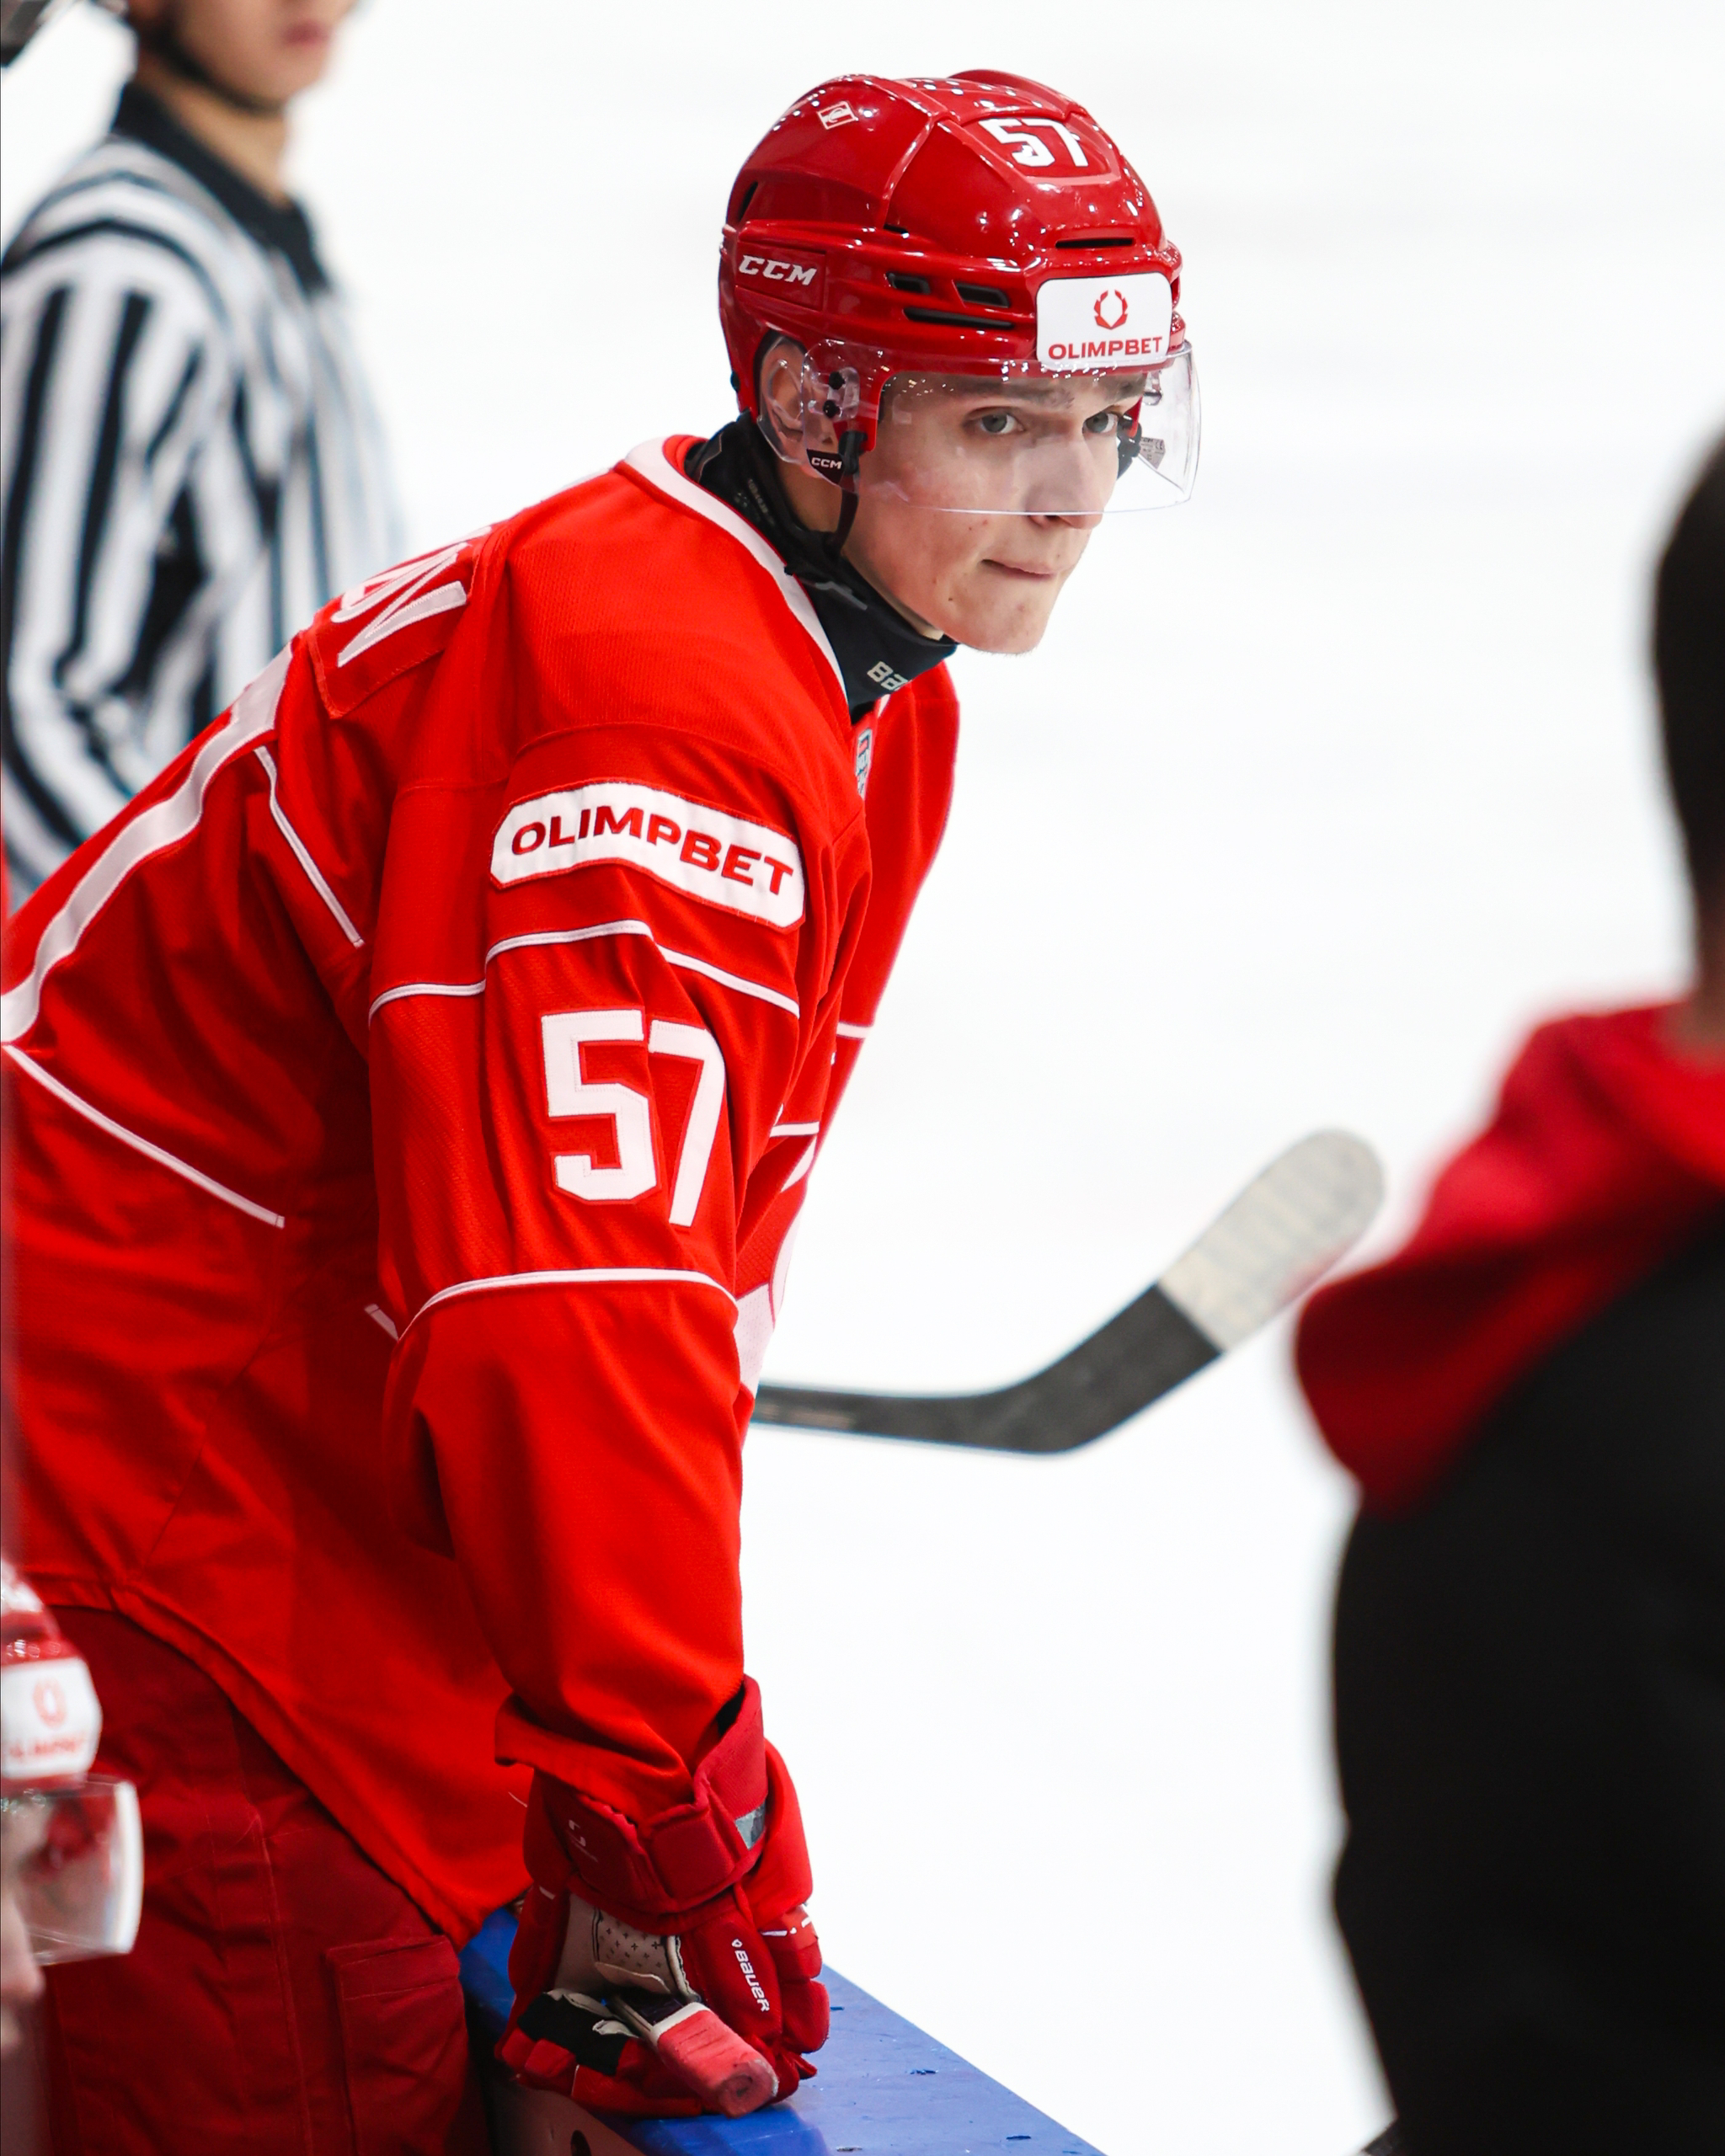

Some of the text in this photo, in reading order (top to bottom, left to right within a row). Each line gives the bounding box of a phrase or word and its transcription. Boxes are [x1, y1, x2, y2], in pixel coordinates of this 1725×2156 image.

[978, 118, 1089, 167] 57
[739, 254, 817, 286] CCM
[1048, 337, 1163, 360] OLIMPBET
[811, 456, 842, 470] CCM
[510, 805, 793, 896] OLIMPBET
[541, 1009, 726, 1227] 57
